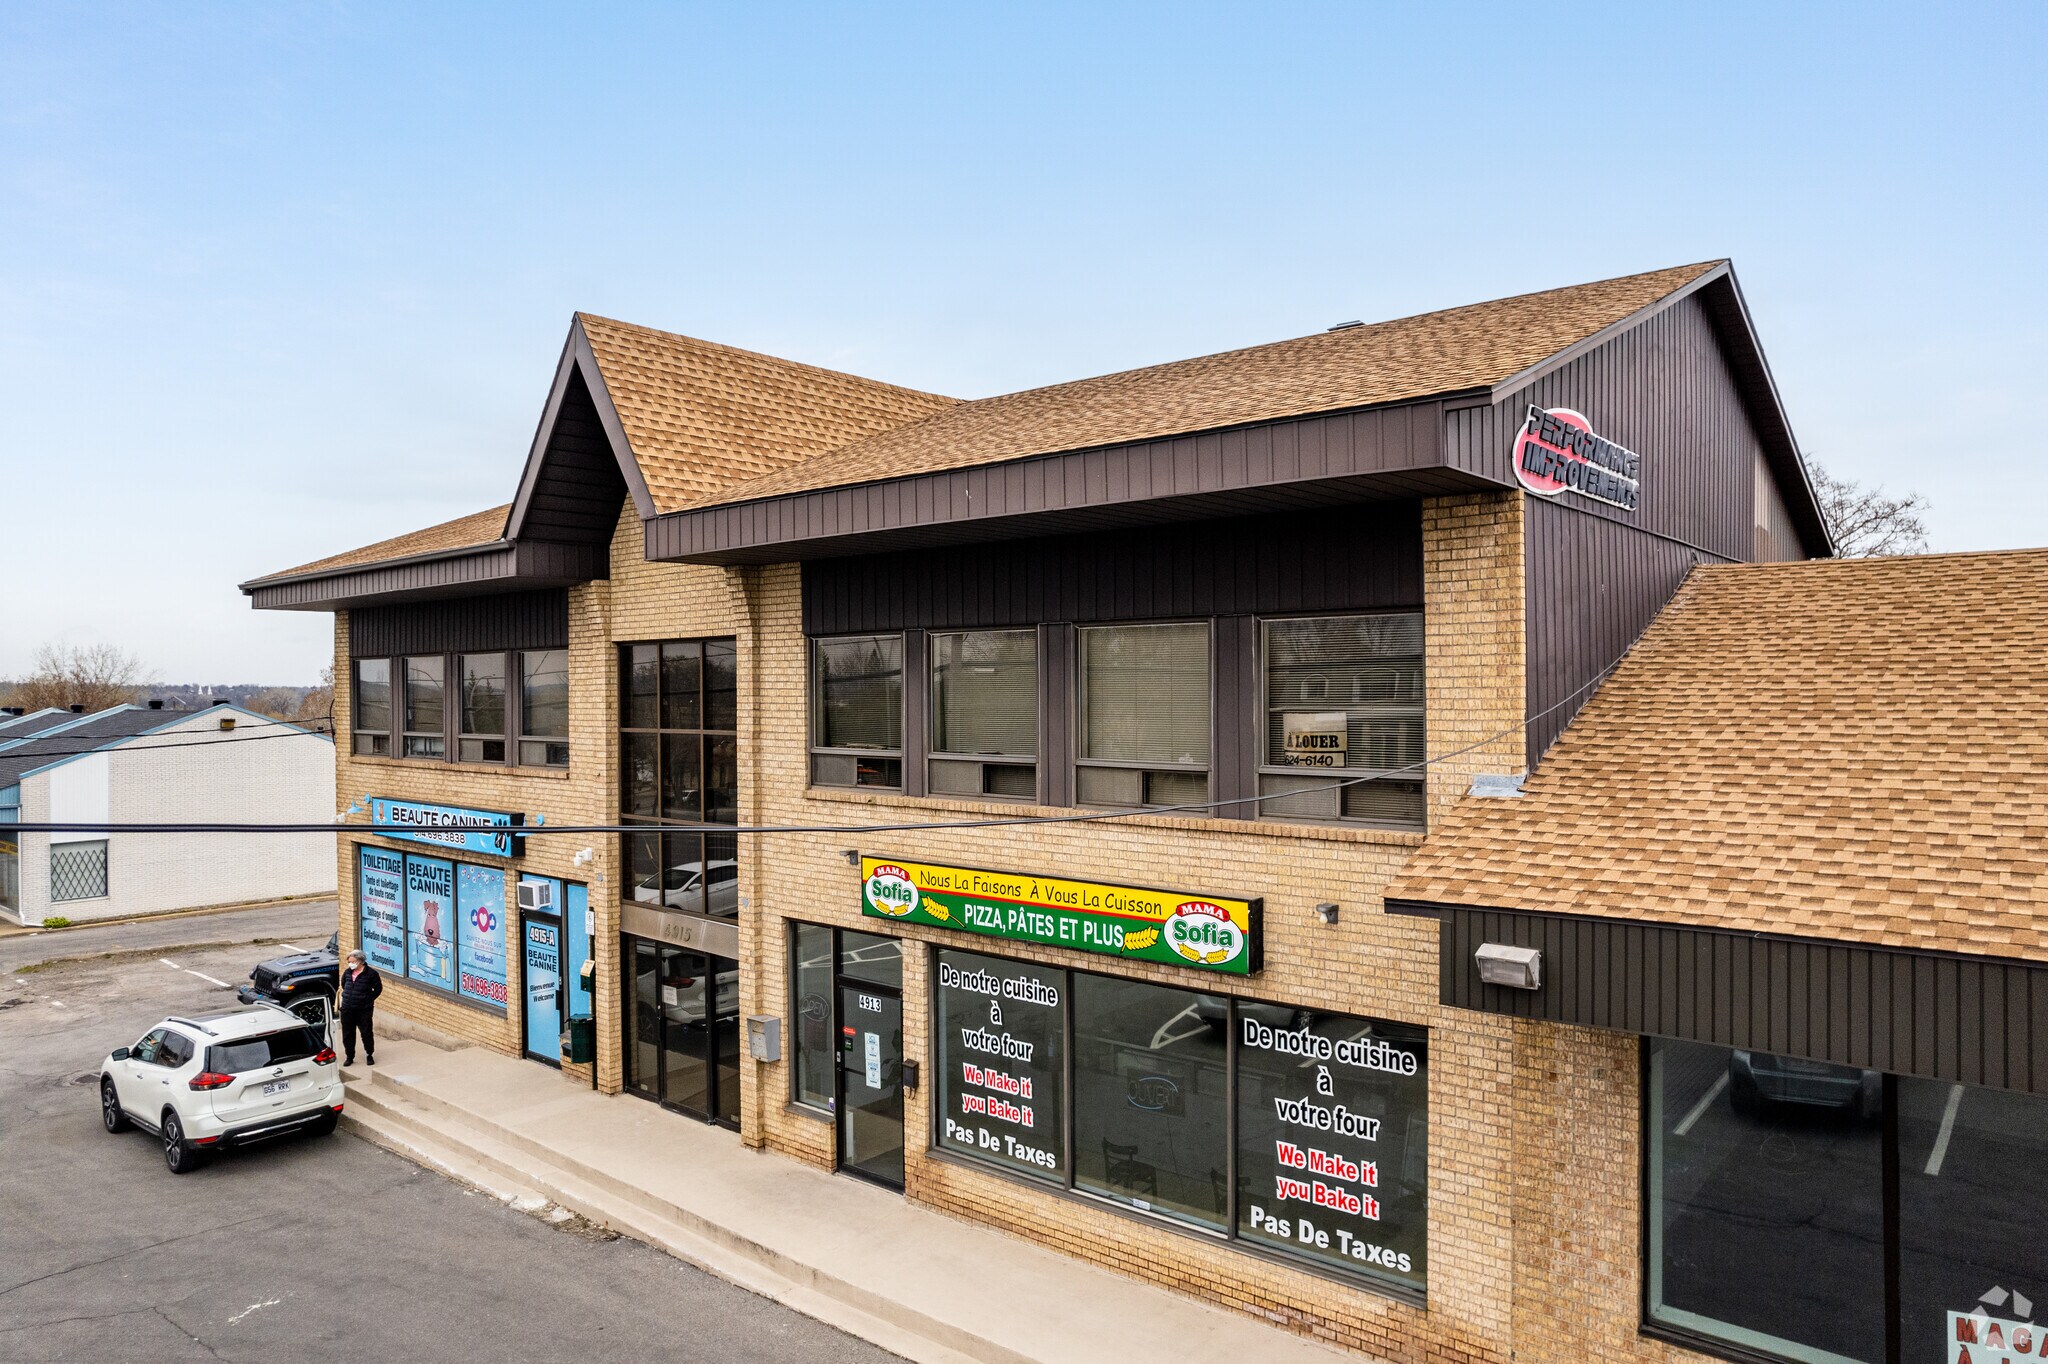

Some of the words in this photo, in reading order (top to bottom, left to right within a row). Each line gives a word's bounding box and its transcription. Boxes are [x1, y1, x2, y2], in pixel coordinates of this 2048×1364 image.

[1528, 406, 1638, 479] PERFORMANCE
[1522, 441, 1639, 508] IMPROVEMENTS
[1296, 735, 1339, 748] LOUER
[392, 807, 438, 826] BEAUTÉ
[441, 813, 491, 834] CANINE
[363, 854, 401, 873] TOILETTAGE
[409, 863, 450, 883] BEAUTE
[877, 866, 906, 879] MAMA
[410, 877, 450, 897] CANINE
[872, 879, 912, 903] Sofia
[920, 870, 950, 888] Nous
[954, 874, 969, 890] La
[973, 876, 1021, 897] Faisons
[1030, 880, 1039, 899] À
[1045, 886, 1078, 904] Vous
[1083, 890, 1099, 907] La
[1105, 893, 1162, 916] Cuisson
[1181, 903, 1224, 920] MAMA
[530, 926, 555, 947] 4915-A
[664, 923, 692, 942] 4915
[964, 904, 1006, 933] PIZZA,
[1008, 907, 1054, 937] PÂTES
[1060, 917, 1078, 940] ET
[1084, 920, 1124, 948] PLUS
[1173, 919, 1234, 948] Sofia
[475, 952, 493, 965] facebook
[528, 949, 557, 965] BEAUTE
[529, 958, 557, 973] CANINE
[462, 971, 474, 993] 514
[530, 981, 555, 992] Bienvenue
[940, 963, 959, 988] De
[962, 968, 999, 995] notre
[1003, 977, 1058, 1006] cuisine
[533, 993, 555, 1003] Welcome
[860, 995, 881, 1011] 4913
[990, 1000, 1002, 1025] à
[962, 1027, 1000, 1054] votre
[1002, 1033, 1033, 1062] four
[1244, 1018, 1273, 1049] De
[1275, 1027, 1331, 1060] notre
[1335, 1038, 1417, 1075] cuisine
[963, 1063, 984, 1085] We
[984, 1068, 1019, 1095] Make
[1020, 1077, 1032, 1099] it
[1317, 1065, 1334, 1096] à
[962, 1093, 985, 1114] you
[988, 1096, 1020, 1122] Bake
[1021, 1106, 1033, 1127] it
[1275, 1097, 1331, 1130] votre
[1334, 1105, 1380, 1141] four
[946, 1118, 974, 1144] Pas
[979, 1128, 1000, 1151] De
[1005, 1136, 1055, 1169] Taxes
[1276, 1140, 1307, 1169] We
[1308, 1148, 1359, 1183] Make
[1361, 1161, 1378, 1187] it
[1276, 1176, 1310, 1201] you
[1312, 1181, 1361, 1215] Bake
[1362, 1196, 1380, 1220] it
[1251, 1205, 1291, 1238] Pas
[1299, 1219, 1329, 1249] De
[1336, 1230, 1412, 1273] Taxes
